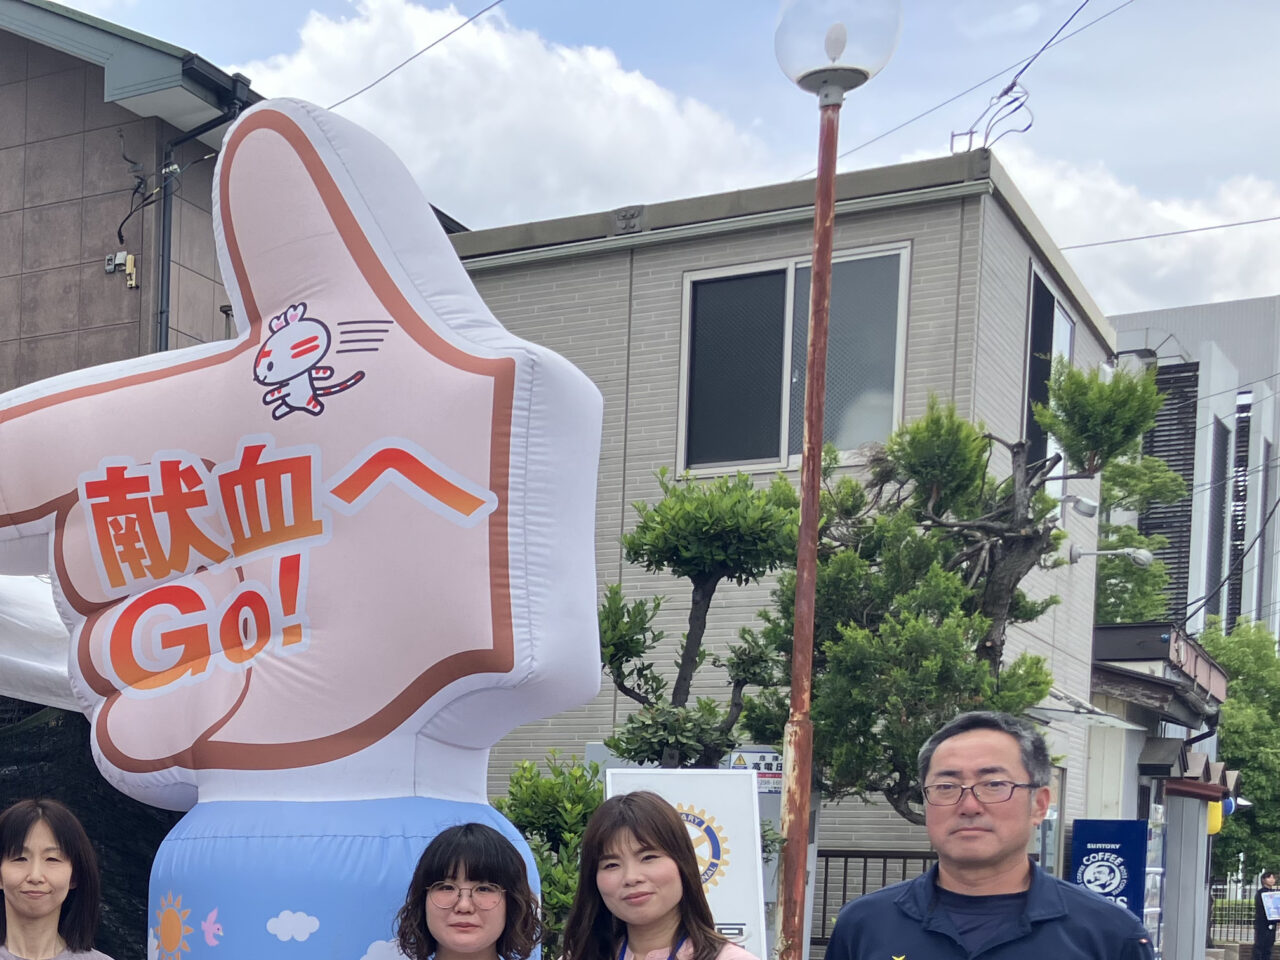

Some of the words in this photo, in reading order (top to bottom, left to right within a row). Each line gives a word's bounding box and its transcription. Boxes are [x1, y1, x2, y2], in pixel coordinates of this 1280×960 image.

[84, 444, 487, 589] 献血へ
[109, 553, 303, 691] Go!
[1082, 852, 1124, 866] COFFEE
